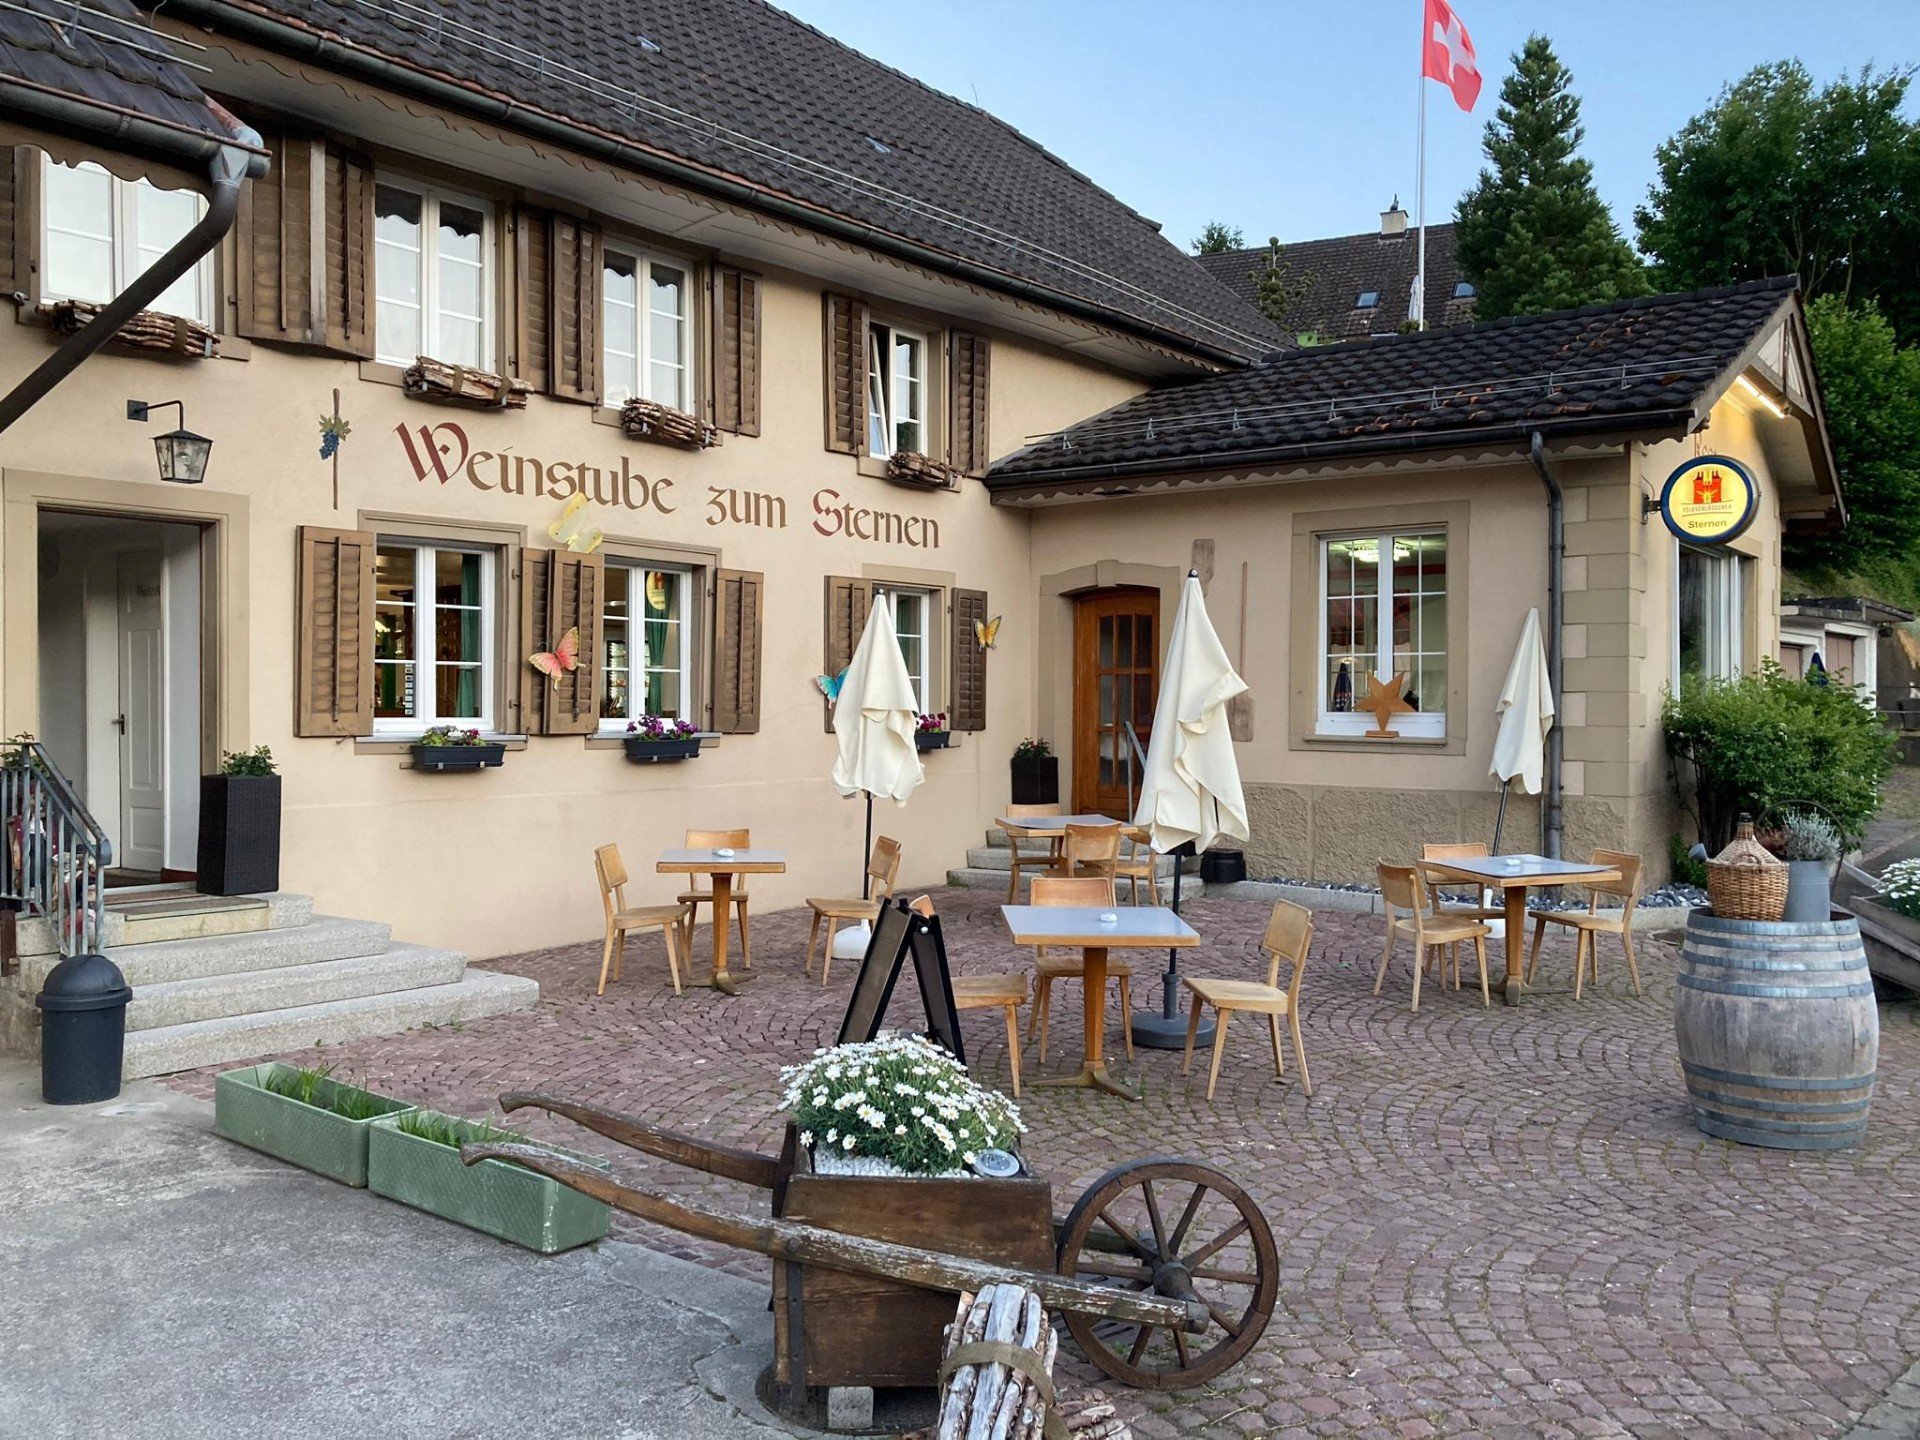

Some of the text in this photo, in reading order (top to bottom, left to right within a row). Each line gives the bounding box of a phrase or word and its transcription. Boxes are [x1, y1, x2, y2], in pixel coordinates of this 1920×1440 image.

[392, 421, 941, 549] Weinstube zum Sternen
[1688, 520, 1727, 529] Sternen
